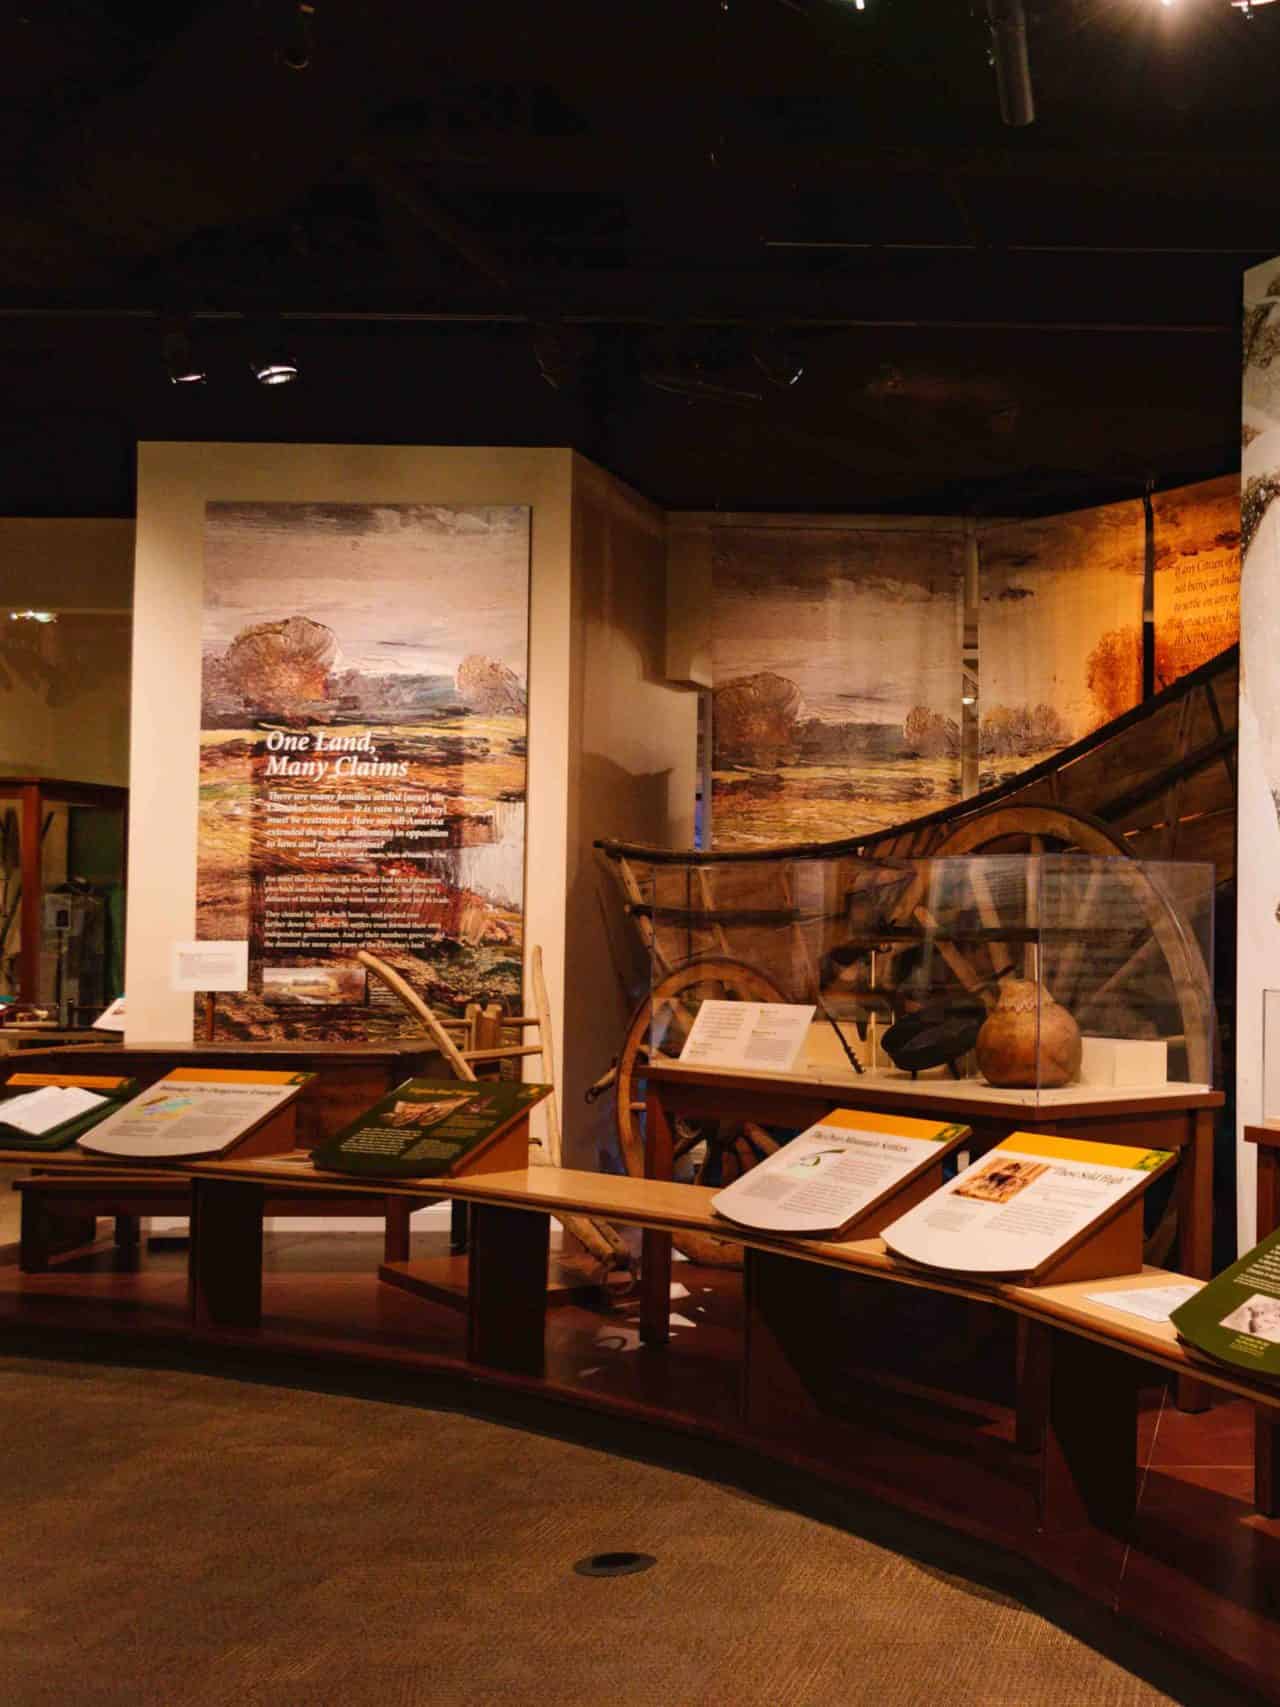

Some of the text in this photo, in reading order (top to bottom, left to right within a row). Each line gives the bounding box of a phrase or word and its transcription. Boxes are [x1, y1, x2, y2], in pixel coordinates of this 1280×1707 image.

[266, 731, 377, 754] One Land,
[264, 755, 409, 782] Many Claims
[408, 815, 445, 825] America
